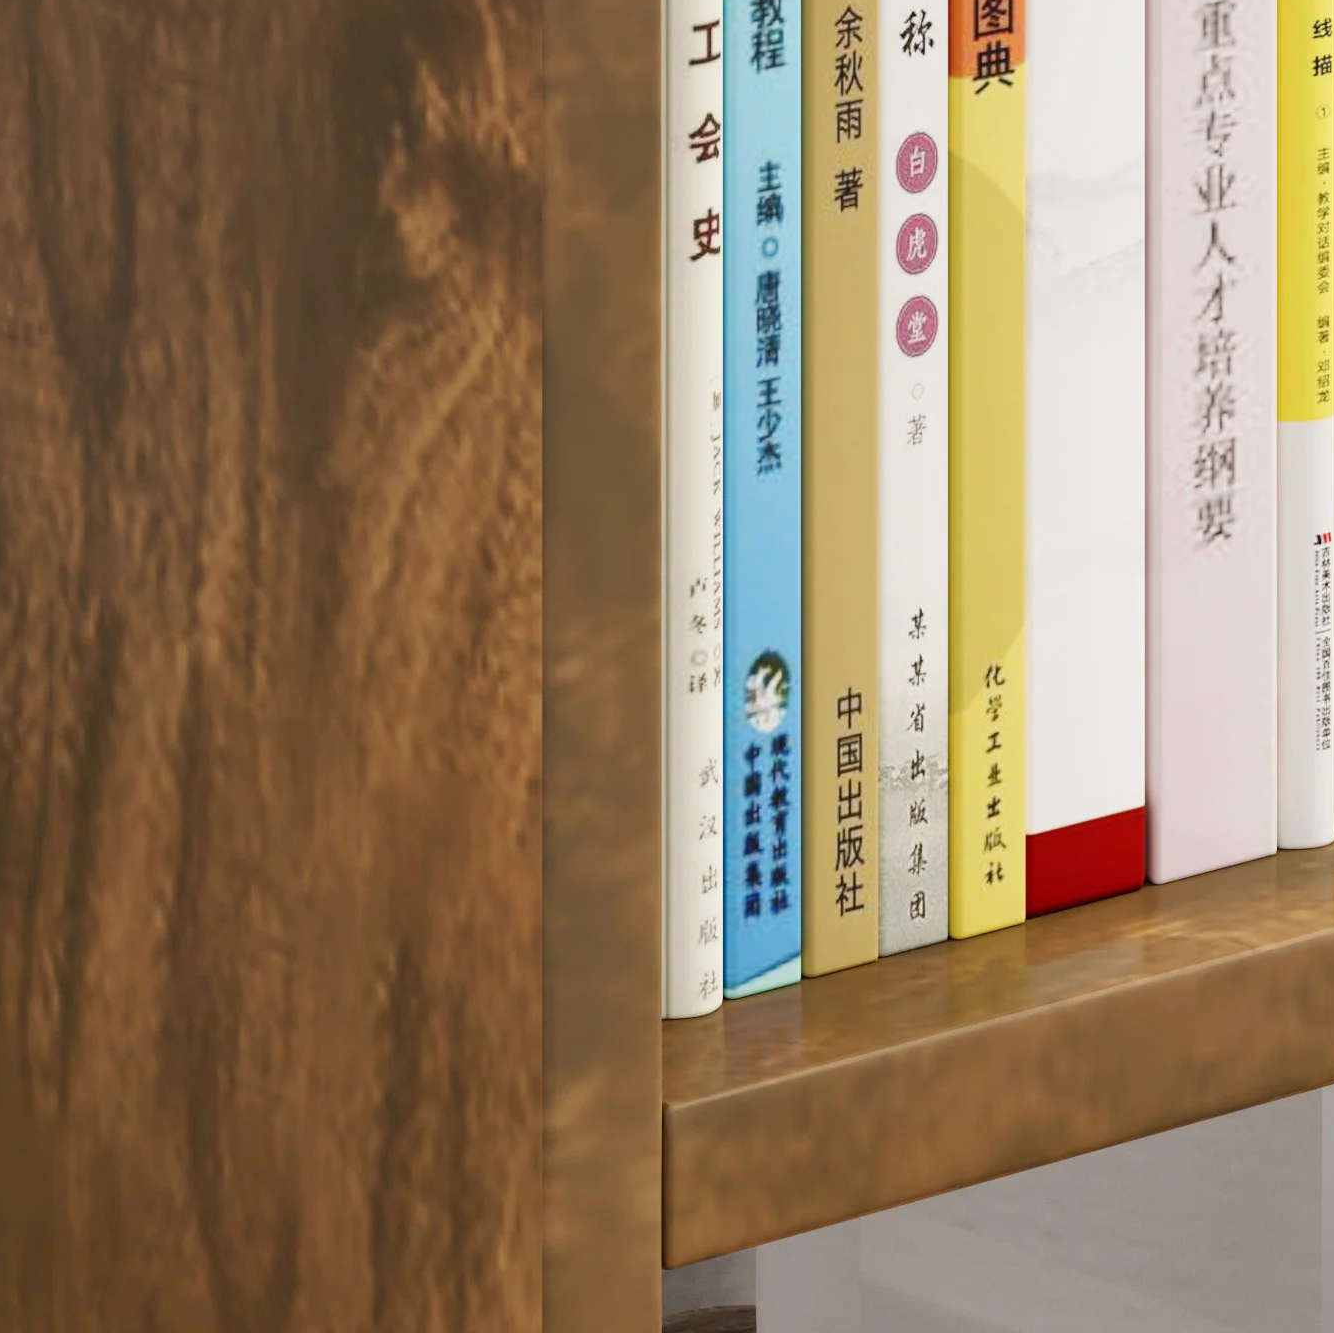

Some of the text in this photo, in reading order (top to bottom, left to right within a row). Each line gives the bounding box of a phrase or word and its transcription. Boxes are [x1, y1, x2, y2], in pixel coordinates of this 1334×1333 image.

[834, 5, 864, 212] 余秋雨 著
[1312, 18, 1333, 77] 线描
[835, 686, 865, 917] 中国出版社
[907, 607, 928, 920] 某某省出版集团
[983, 662, 1006, 886] 化学工业出版社
